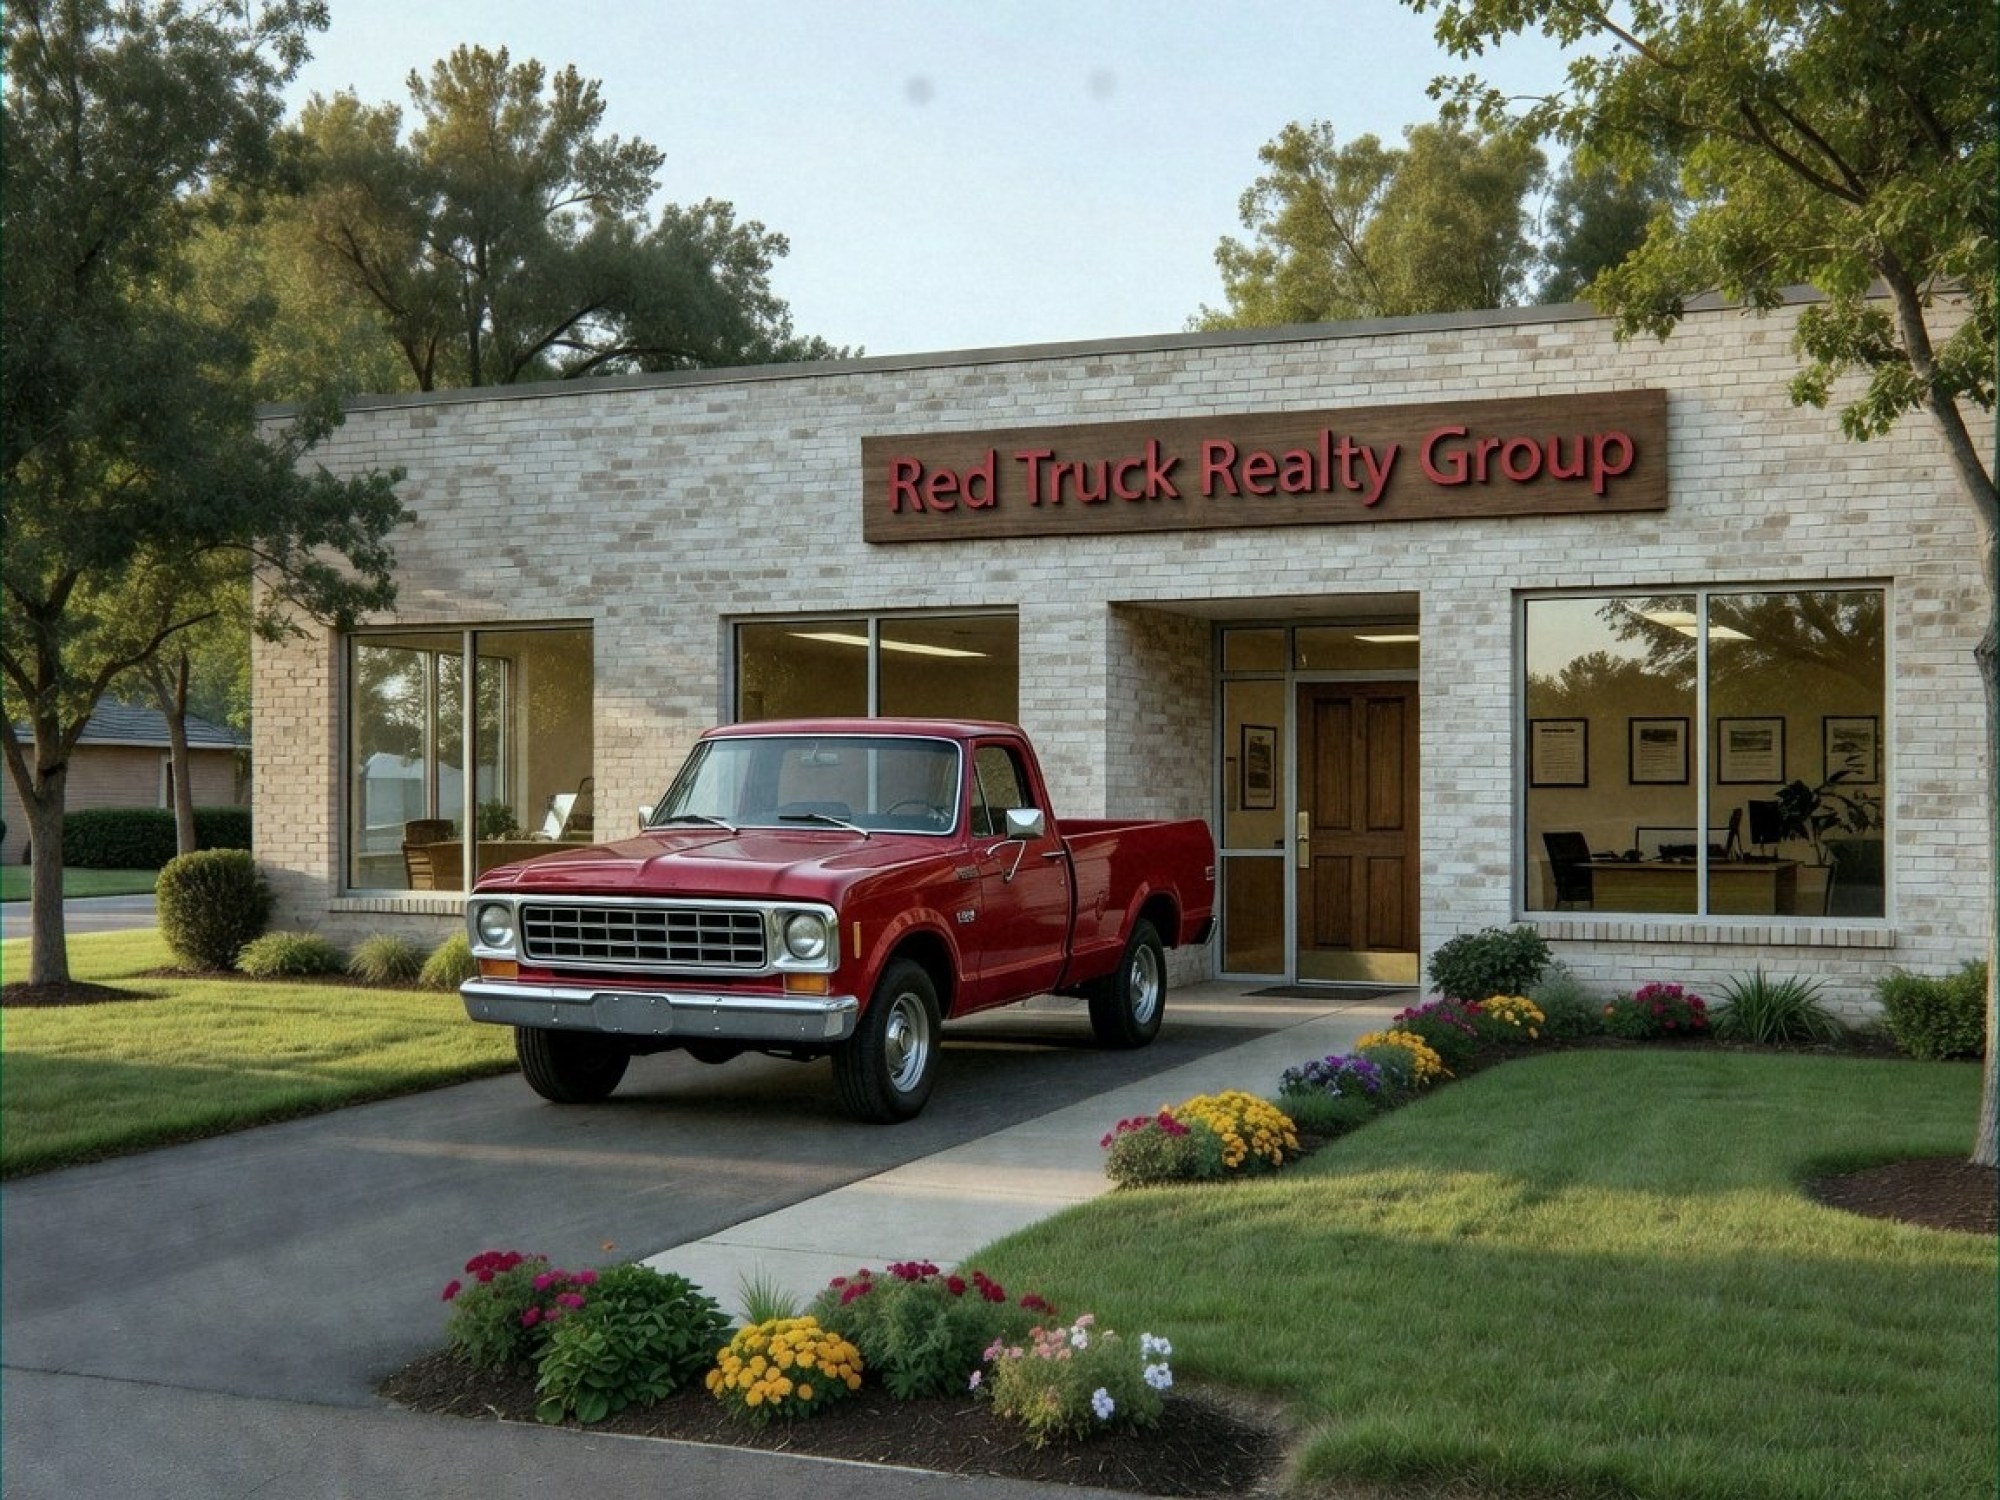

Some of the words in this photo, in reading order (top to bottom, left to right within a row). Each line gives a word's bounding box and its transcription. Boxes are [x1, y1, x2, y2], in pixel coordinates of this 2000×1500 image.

[887, 449, 996, 512] Red
[1016, 439, 1178, 505] Truck
[1200, 429, 1399, 506] Realty
[1419, 426, 1635, 494] Group
